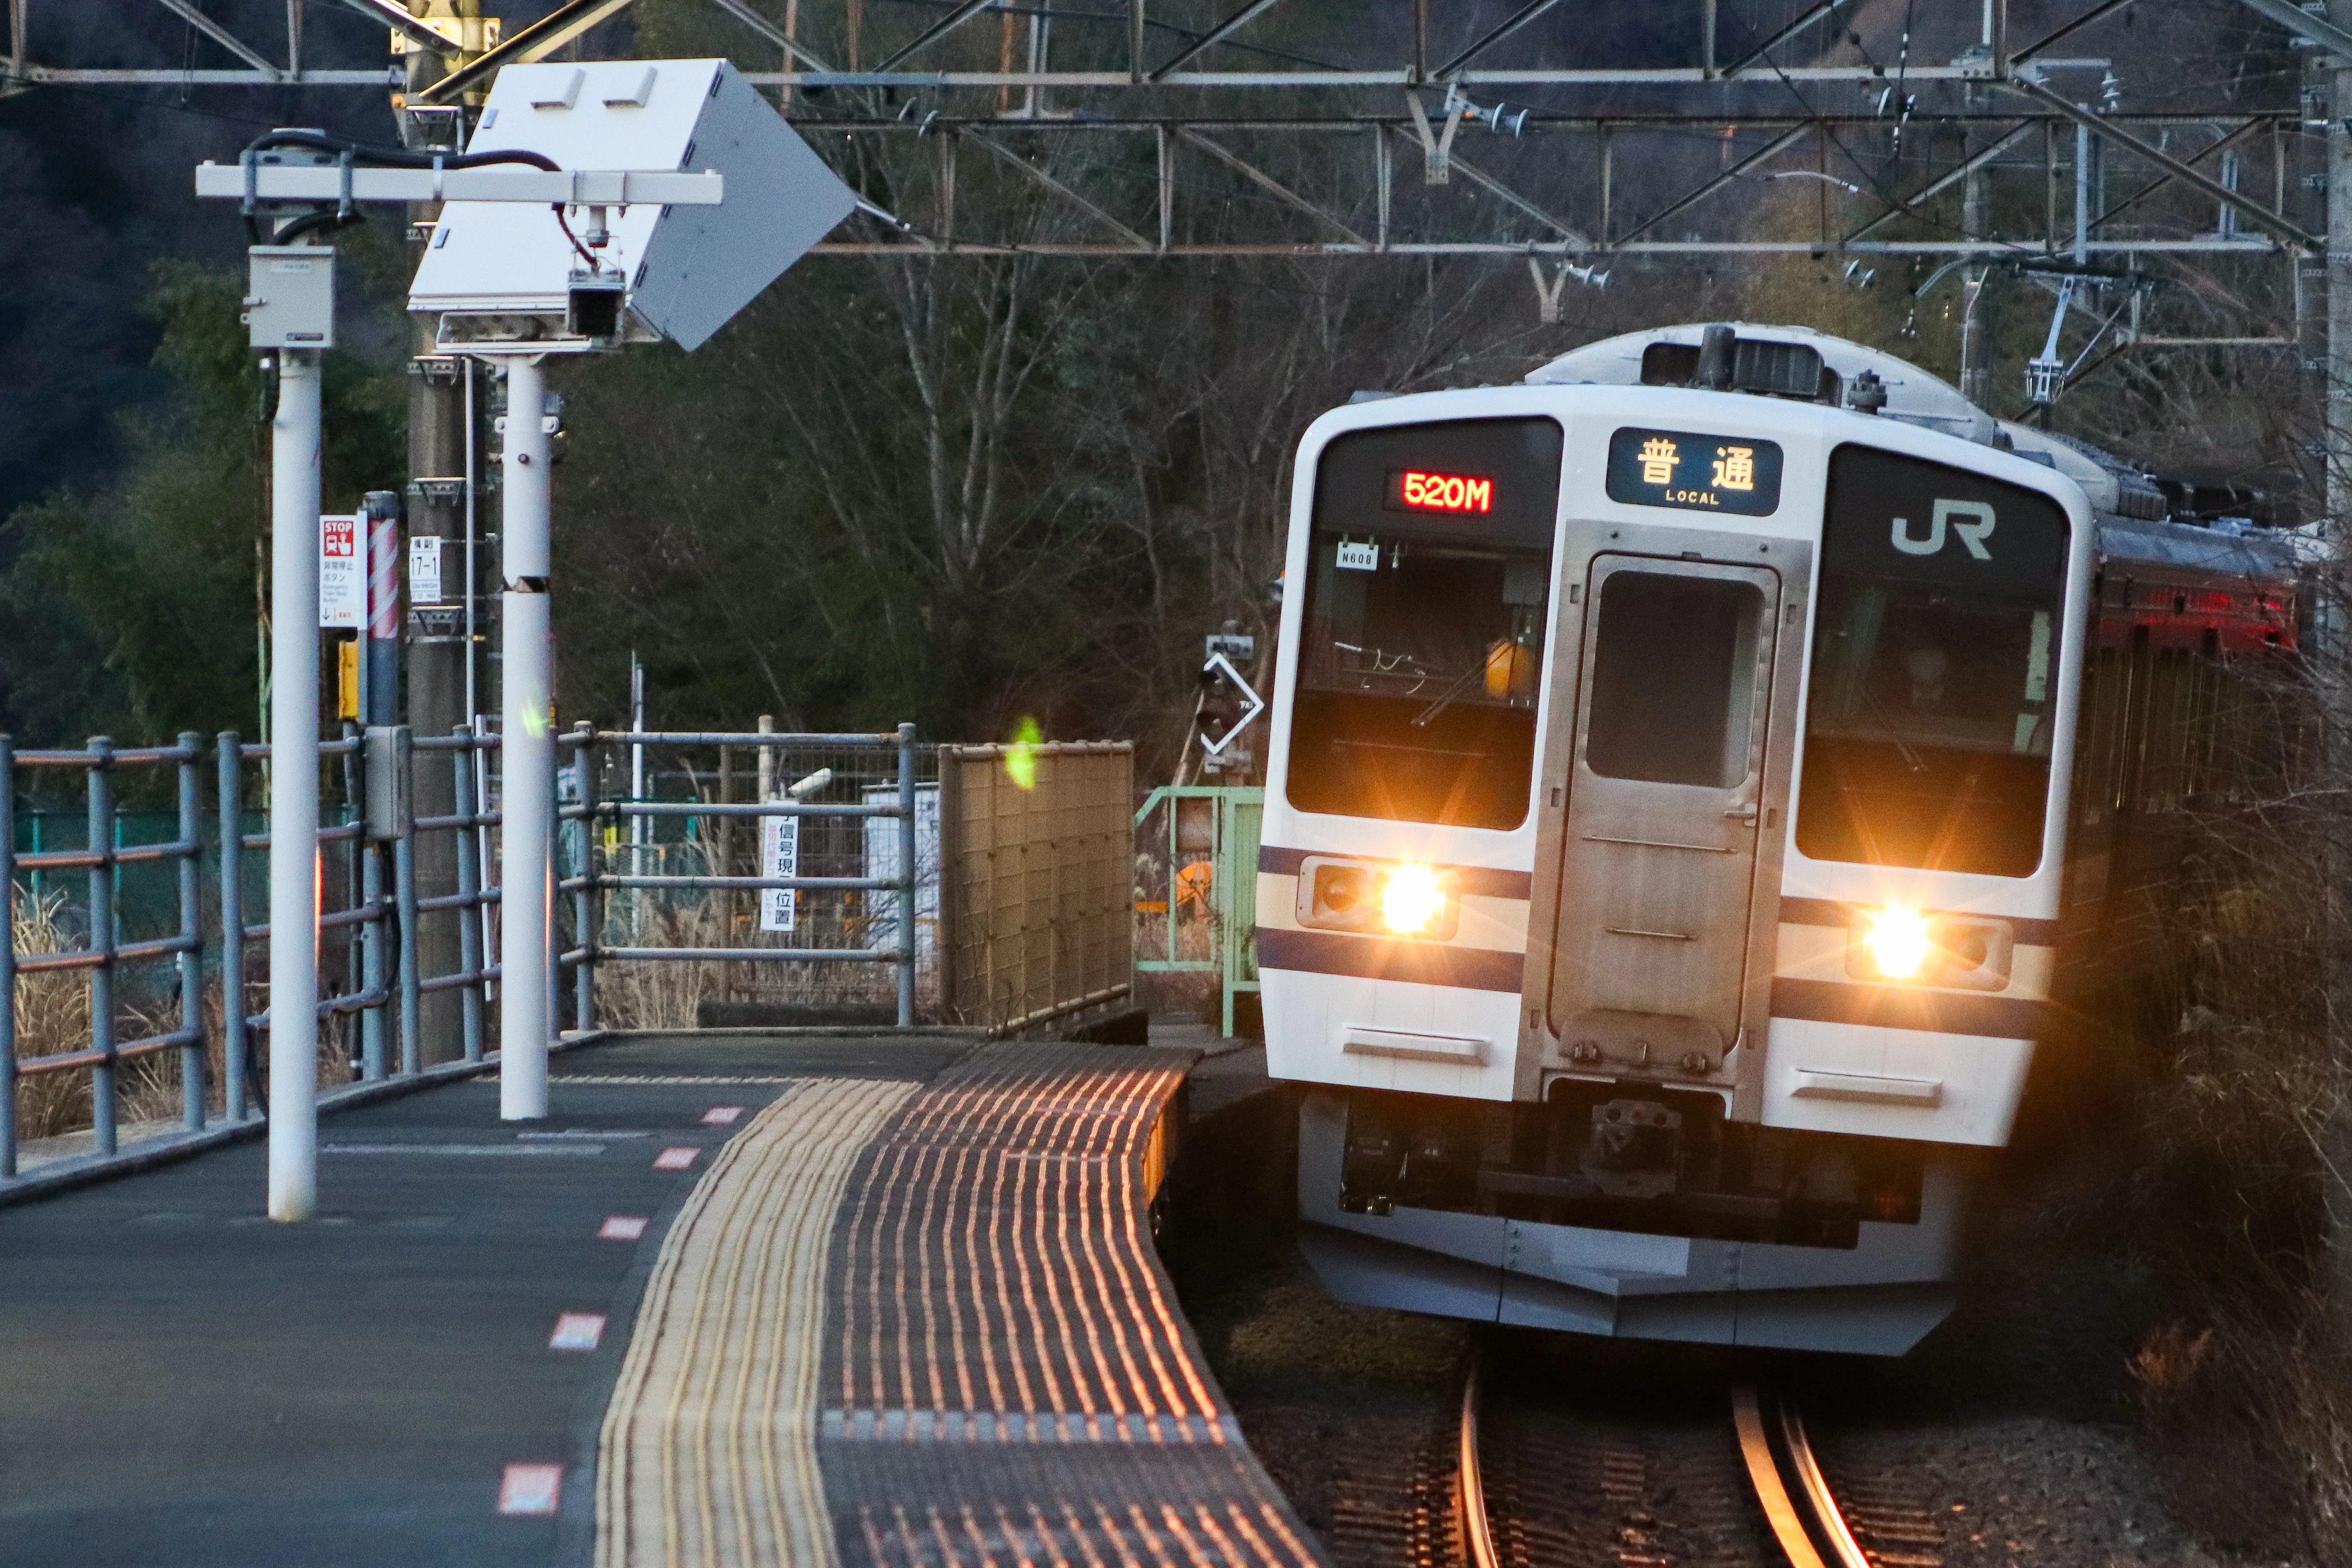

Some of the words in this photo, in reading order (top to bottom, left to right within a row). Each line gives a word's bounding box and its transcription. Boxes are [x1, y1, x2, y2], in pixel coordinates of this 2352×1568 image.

[1637, 437, 1754, 490] 普通
[1404, 471, 1492, 512] 520M
[1666, 489, 1719, 505] LOCAL
[325, 522, 352, 533] STOP
[1892, 498, 1995, 560] JR
[324, 561, 354, 571] 非常停止
[411, 556, 436, 575] 17-1
[324, 573, 345, 582] ボタン
[776, 816, 794, 924] 信号現位置
